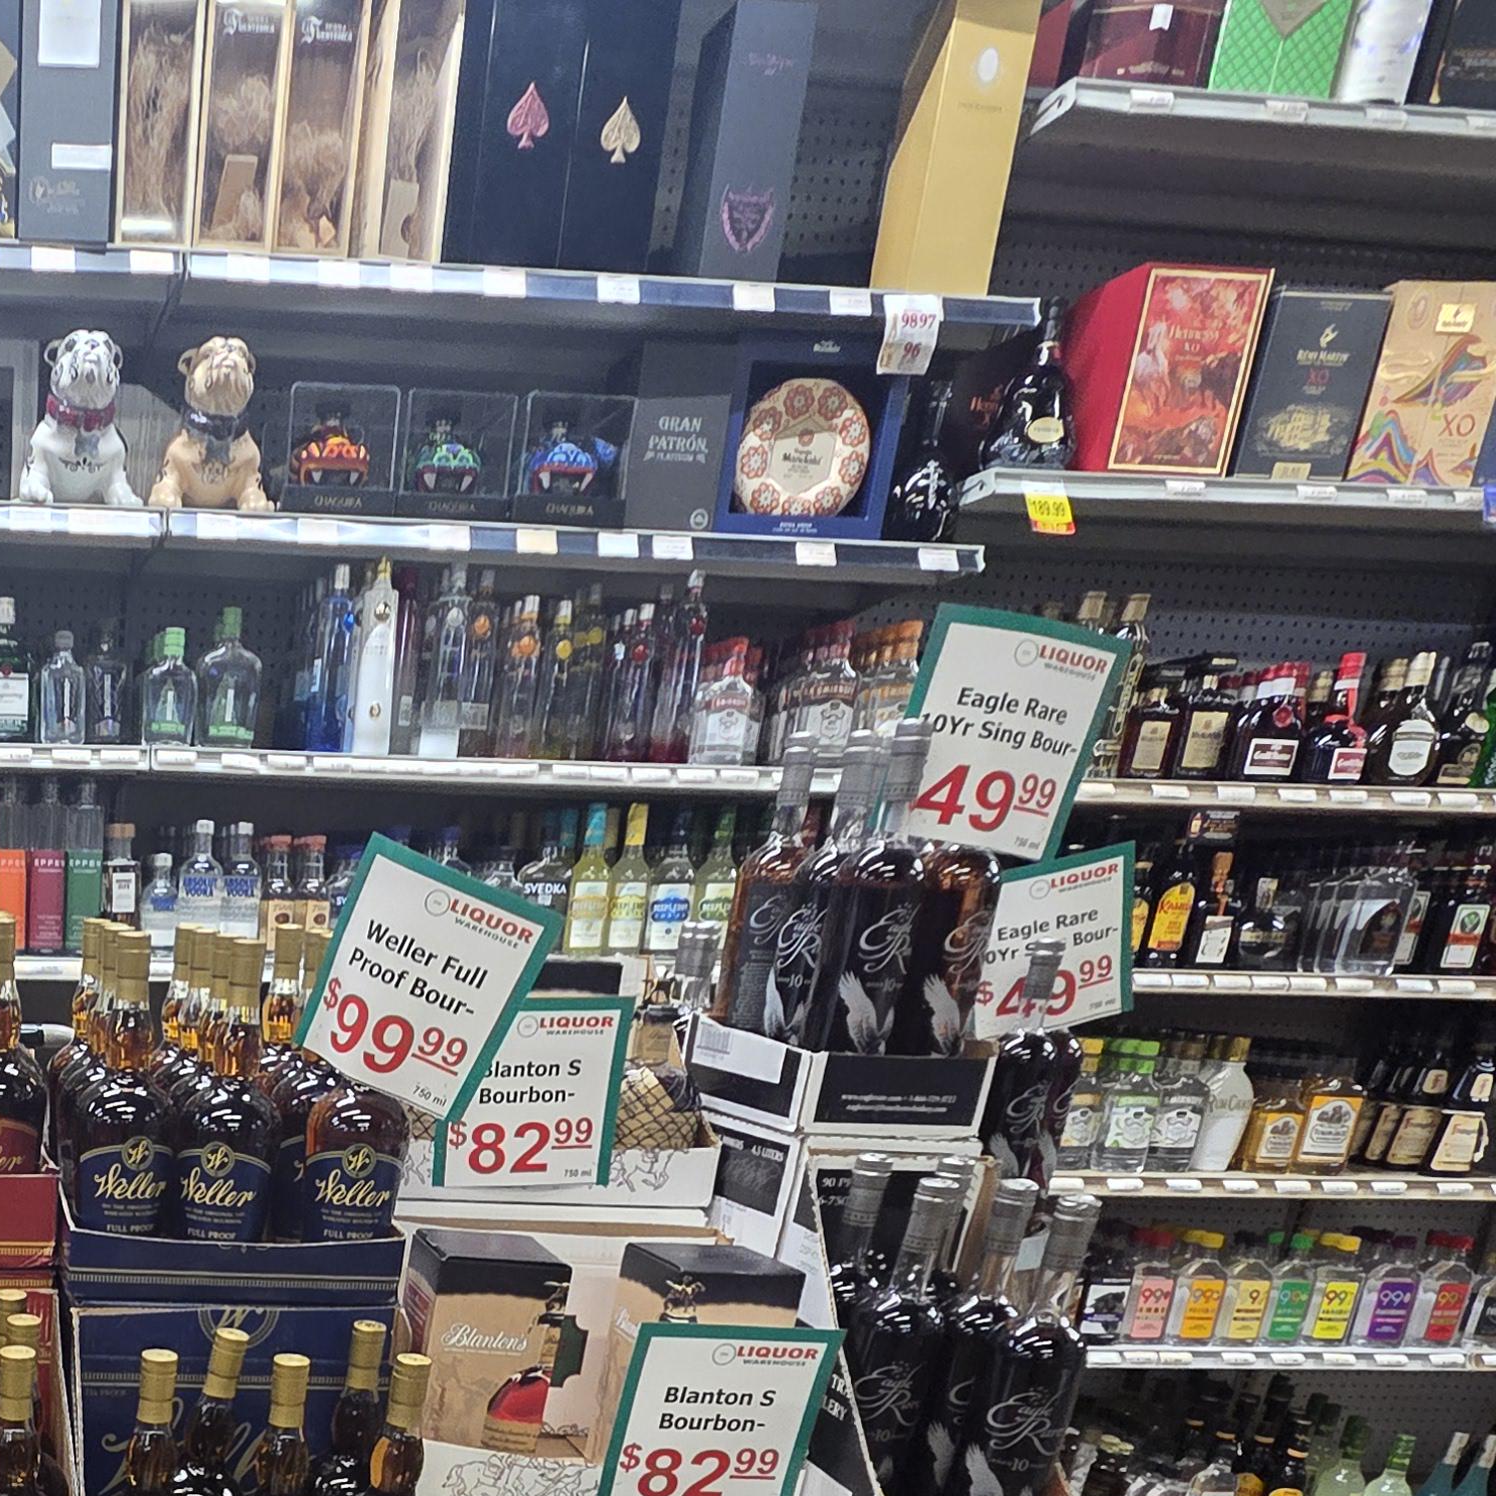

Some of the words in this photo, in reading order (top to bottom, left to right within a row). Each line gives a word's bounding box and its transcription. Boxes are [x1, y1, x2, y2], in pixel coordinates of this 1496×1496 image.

[1439, 413, 1476, 438] XO
[1039, 644, 1108, 674] LIQUOR
[957, 687, 1019, 715] Eagle
[1024, 698, 1068, 725] Rare
[978, 720, 1026, 750] Sing
[1030, 730, 1077, 757] Bour-
[524, 883, 566, 894] SVEDKA
[1050, 863, 1119, 888] LIQUOR
[449, 898, 534, 944] LIQUOR
[454, 916, 519, 950] WAREHOUSE
[997, 920, 1049, 941] Eagle
[1056, 909, 1099, 929] Rare
[366, 919, 439, 968] Weller
[441, 955, 489, 990] Full
[984, 948, 1020, 965] 0Yr
[1073, 926, 1118, 946] Bour-
[348, 947, 409, 990] Proof
[409, 977, 475, 1016] Bour-
[539, 1016, 614, 1029] LIQUOR
[567, 1059, 582, 1076] S
[479, 1086, 575, 1104] Bourbon-
[94, 1163, 167, 1200] Weller
[180, 1167, 255, 1208] Weller
[315, 1168, 392, 1208] Weller
[441, 1322, 530, 1352] Blanton's
[737, 1345, 818, 1359] LIQUOR
[664, 1387, 753, 1406] Blanton
[759, 1390, 776, 1407] S
[659, 1413, 766, 1432] Bourbon-
